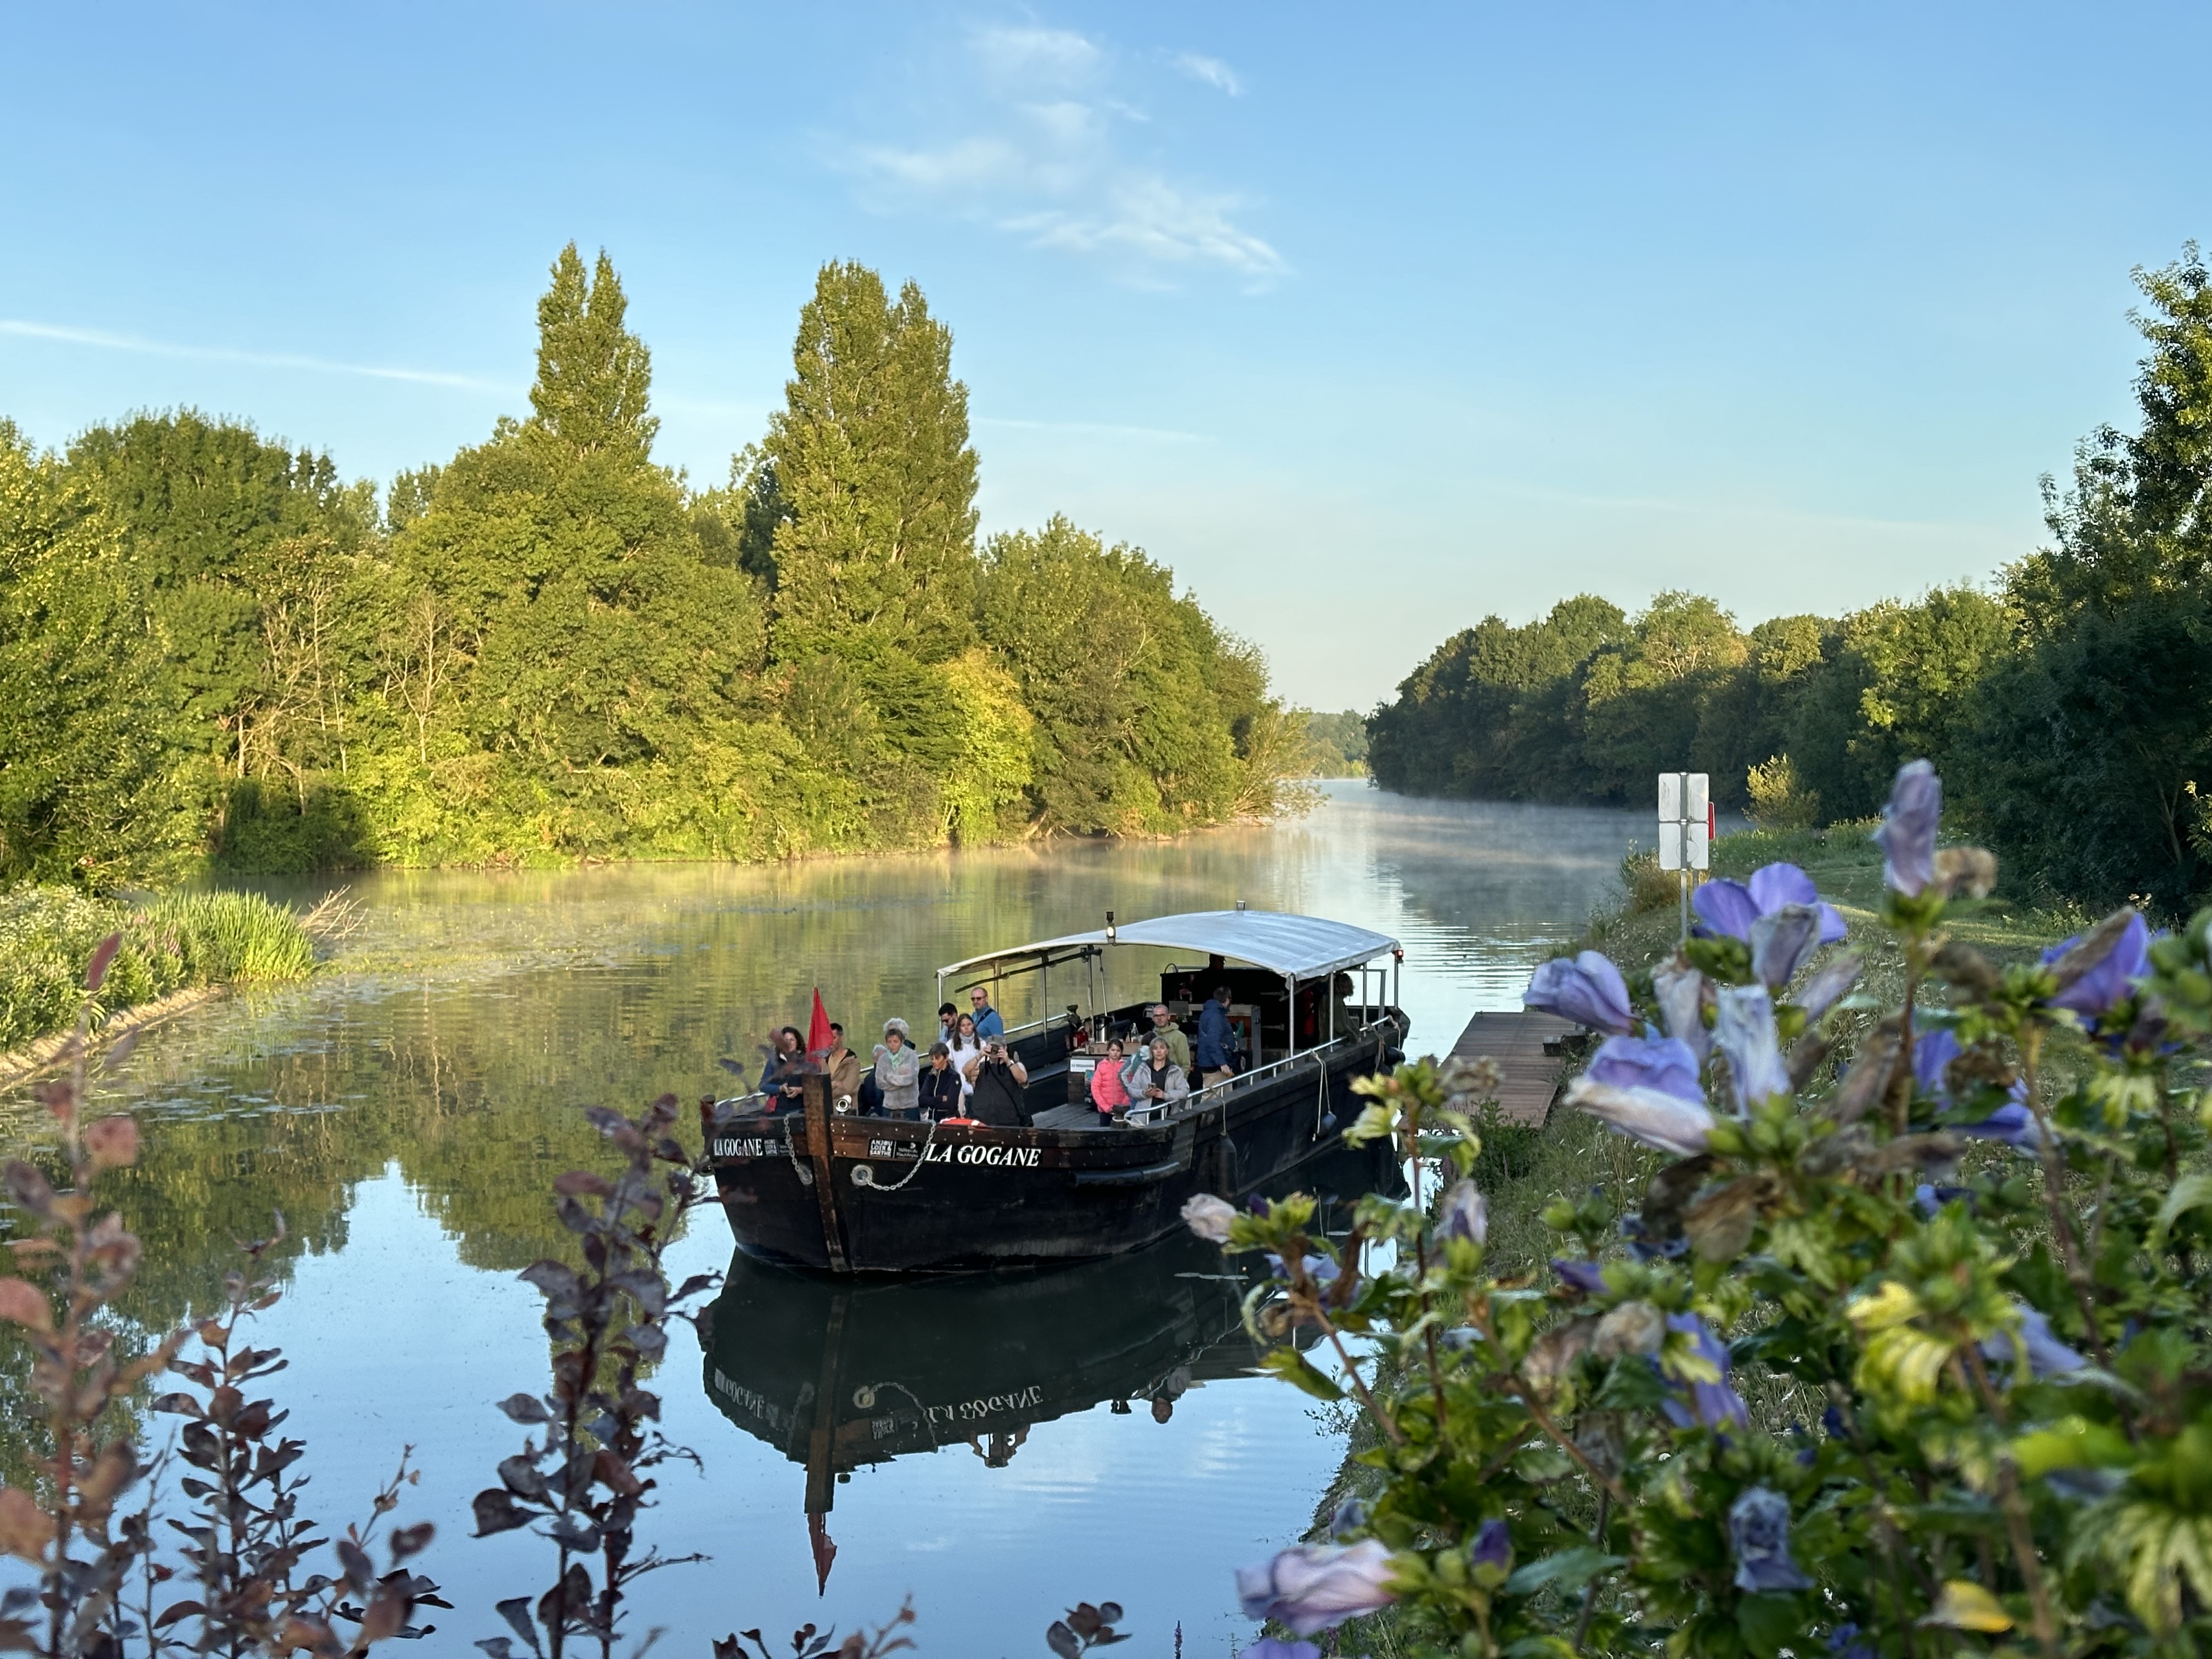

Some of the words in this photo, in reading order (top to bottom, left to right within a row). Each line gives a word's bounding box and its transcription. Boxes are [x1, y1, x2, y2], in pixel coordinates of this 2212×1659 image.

[724, 1138, 763, 1156] GOGANE
[924, 1143, 952, 1162] LA
[957, 1145, 1041, 1166] GOGANE
